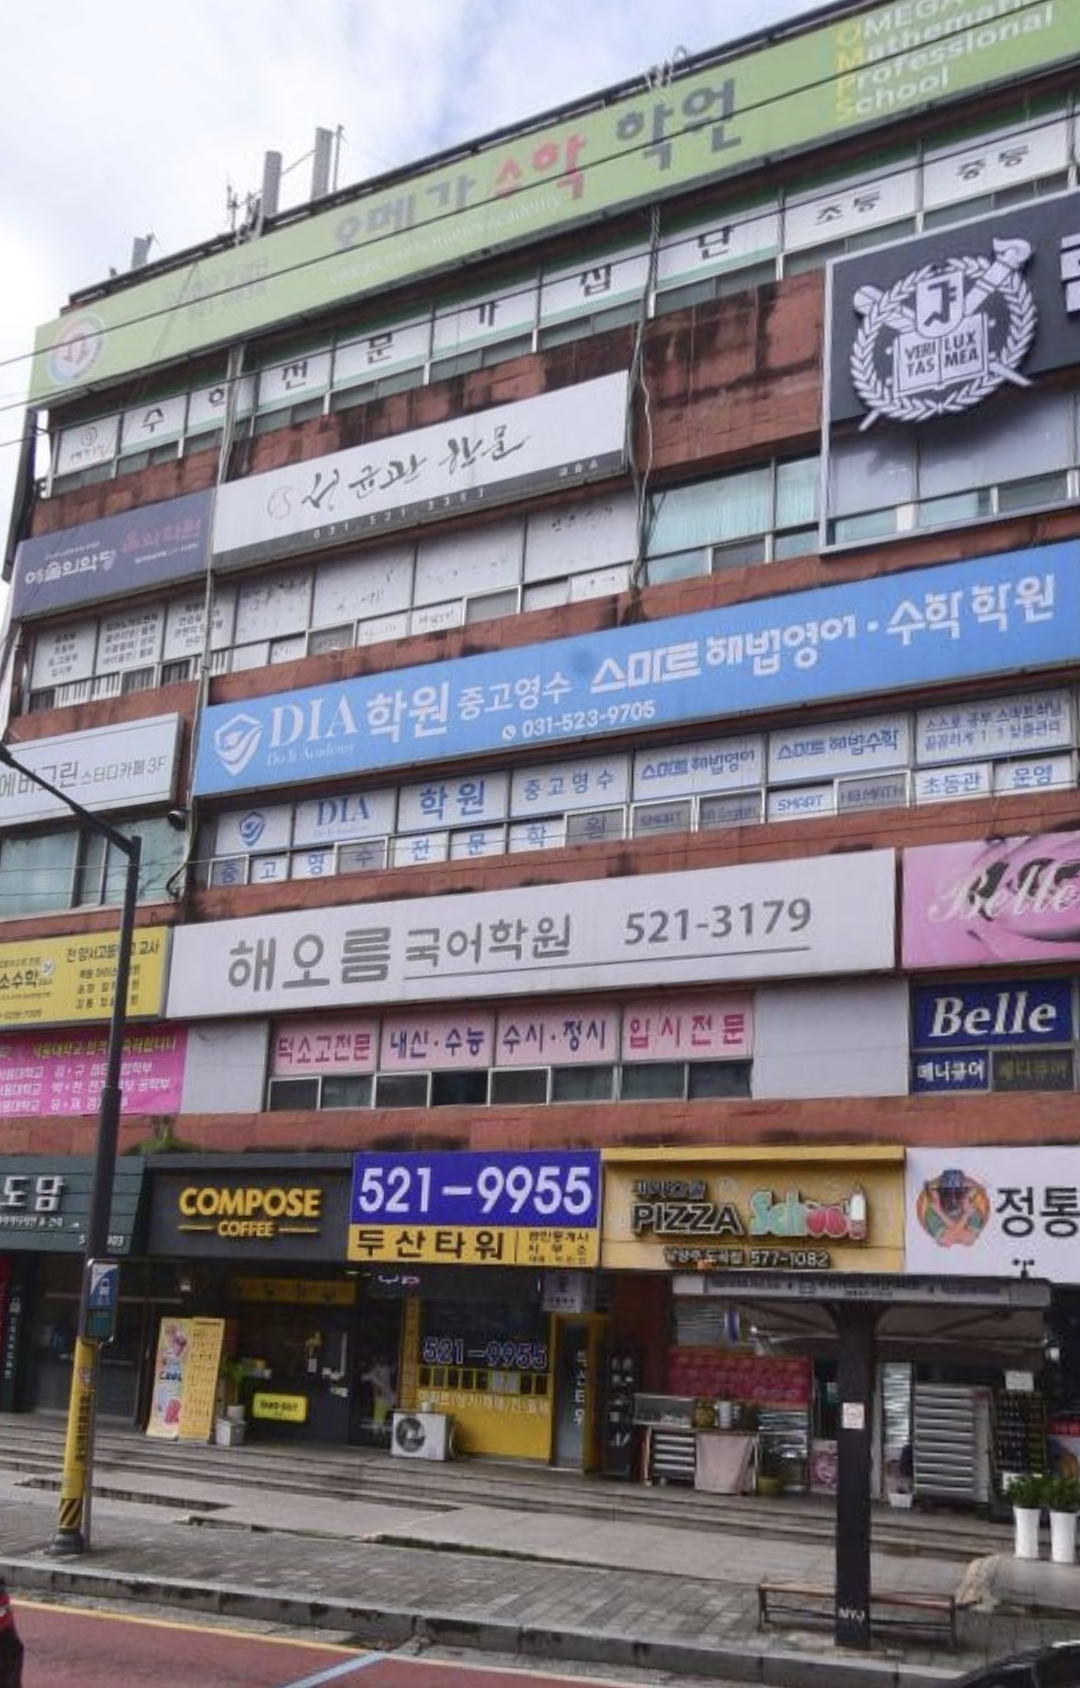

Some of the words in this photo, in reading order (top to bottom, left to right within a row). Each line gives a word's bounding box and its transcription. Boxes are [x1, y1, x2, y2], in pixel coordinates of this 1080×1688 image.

[836, 66, 949, 122] School
[615, 78, 742, 171] 학원
[943, 331, 977, 351] LUX
[905, 357, 936, 378] TAS
[943, 348, 978, 369] MEA
[971, 574, 1056, 633] 학원
[267, 696, 358, 748] DIA
[366, 682, 450, 744] 학원
[457, 672, 573, 721] 중고영수
[316, 796, 370, 827] DIA
[419, 779, 486, 821] 학원
[777, 793, 825, 812] SMART
[624, 898, 812, 946] 521-3179
[227, 927, 391, 992] 해오름
[405, 913, 571, 968] 국어학원
[629, 1013, 745, 1049] 입시전문
[927, 990, 1058, 1038] Belle
[277, 1032, 371, 1064] 덕소고전문
[389, 1026, 485, 1059] 내신·수능
[503, 1018, 606, 1054] 수시·정시
[179, 1186, 322, 1218] COMPOSE
[358, 1165, 593, 1216] 521-9955
[217, 1219, 275, 1237] COFFEE
[631, 1202, 746, 1236] PIZZA
[995, 1186, 1080, 1238] 정통
[356, 1229, 505, 1261] 두산타워
[750, 1250, 830, 1268] 577-1082
[422, 1336, 549, 1371] 521-9955
